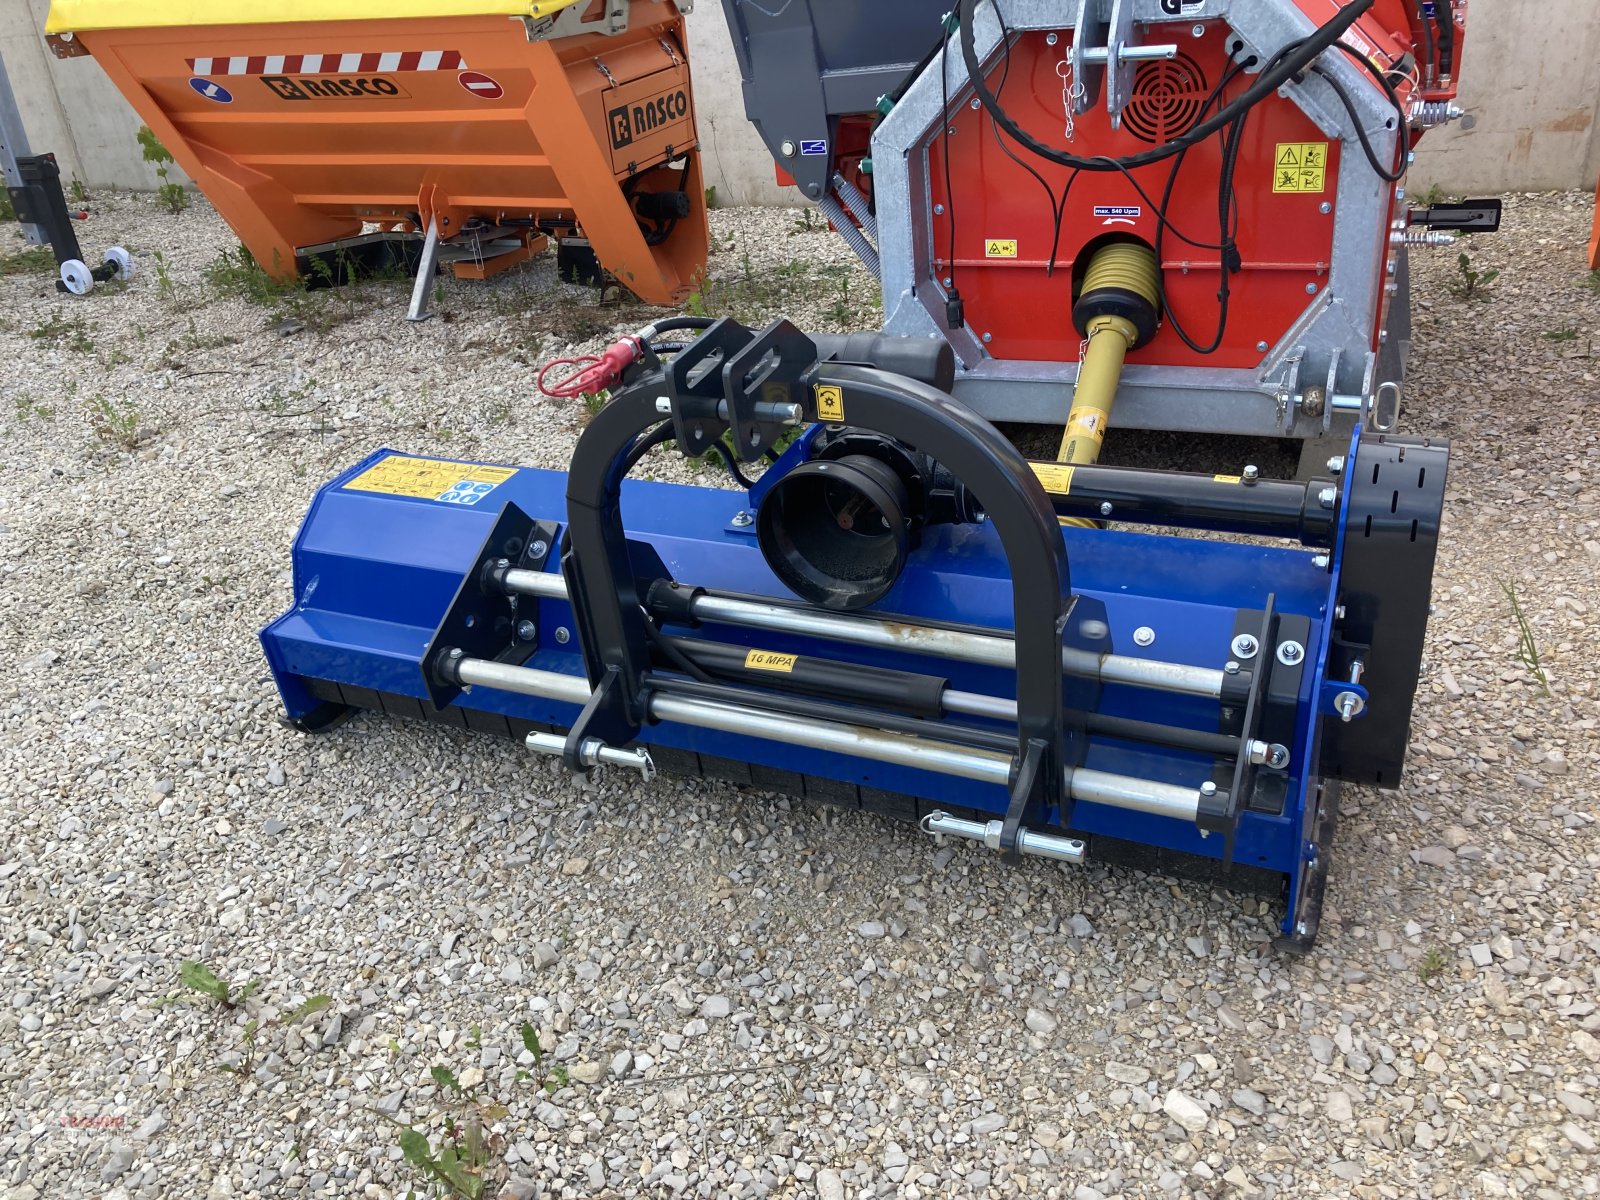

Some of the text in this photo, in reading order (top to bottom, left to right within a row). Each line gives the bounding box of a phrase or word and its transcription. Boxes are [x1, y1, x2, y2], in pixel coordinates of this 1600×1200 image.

[299, 78, 399, 97] RASCO
[632, 90, 687, 135] RASCO
[750, 653, 792, 667] 16 MPA
